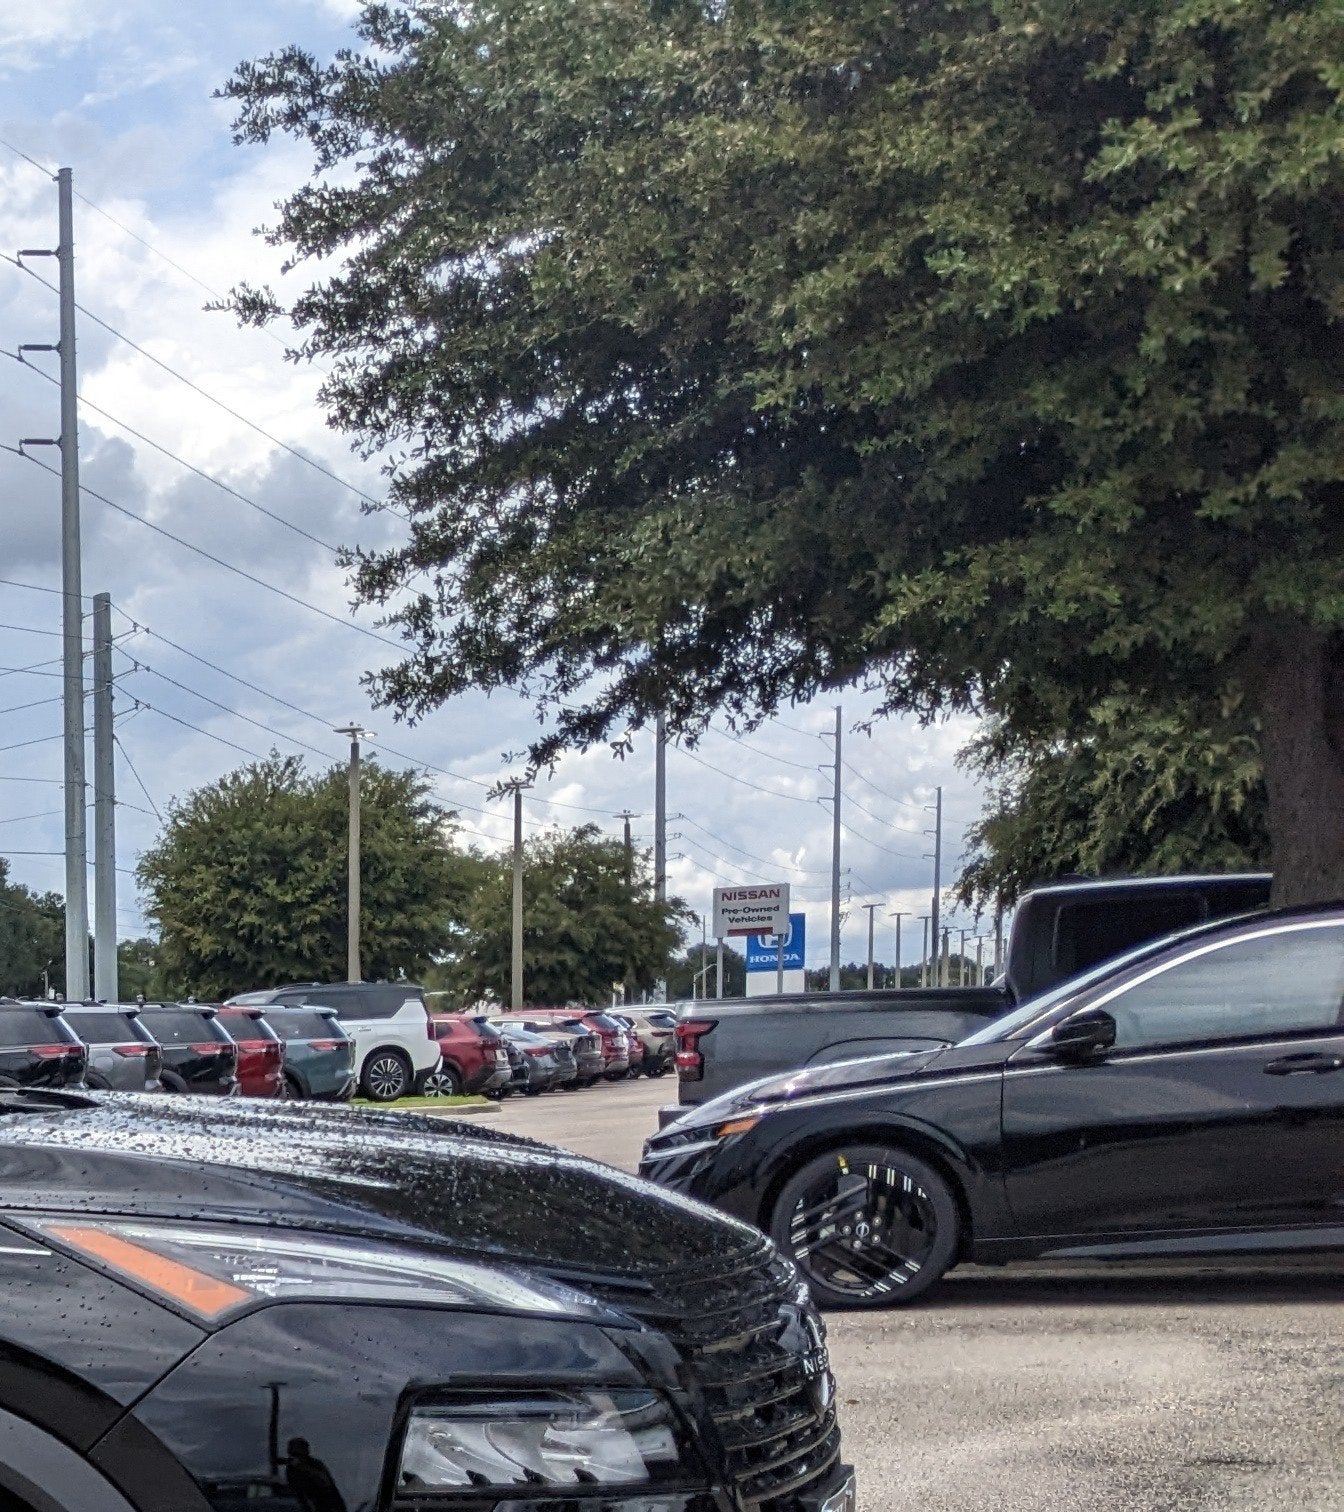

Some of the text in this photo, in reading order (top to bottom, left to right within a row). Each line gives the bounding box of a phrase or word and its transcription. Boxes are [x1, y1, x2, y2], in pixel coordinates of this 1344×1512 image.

[721, 889, 781, 901] NISSAN
[721, 904, 780, 915] Pre-Owned
[728, 915, 773, 924] Vehicles
[749, 953, 801, 963] HONDA
